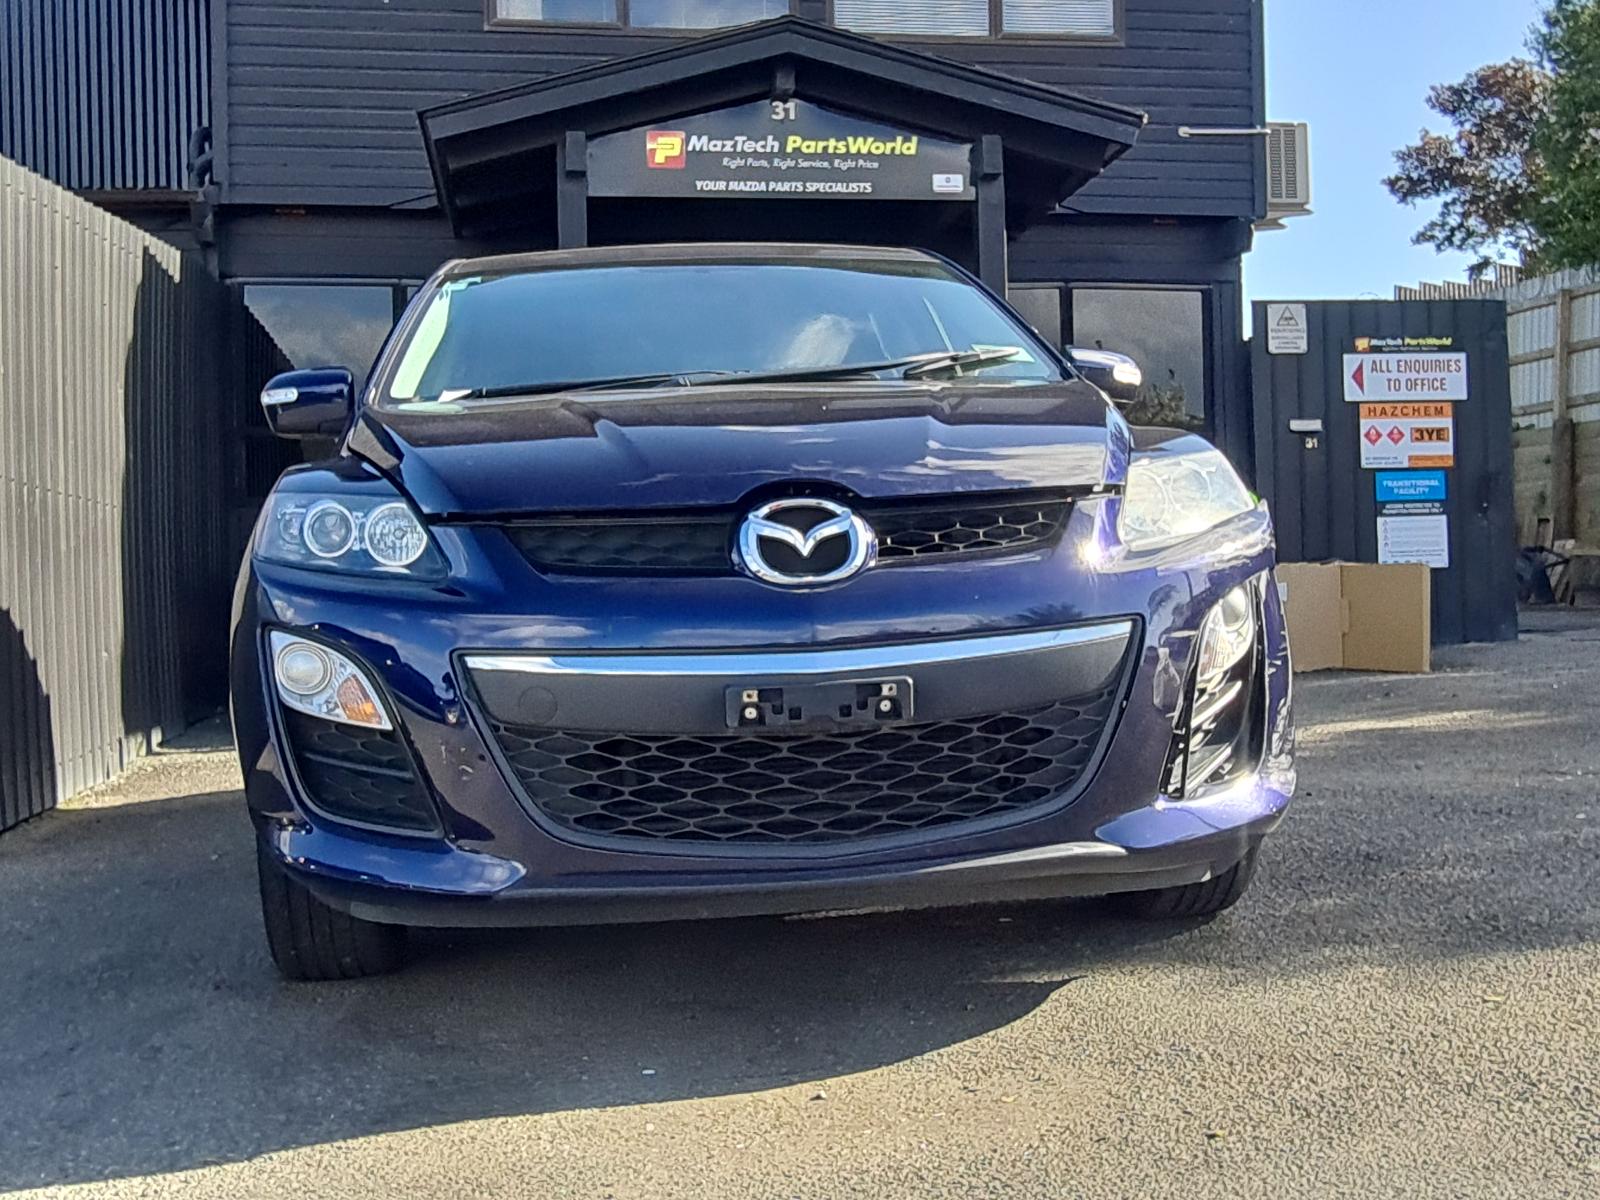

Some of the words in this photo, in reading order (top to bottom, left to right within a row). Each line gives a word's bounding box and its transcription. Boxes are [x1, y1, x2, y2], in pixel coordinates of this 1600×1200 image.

[771, 101, 796, 120] 31
[687, 135, 780, 153] MazTech
[786, 135, 918, 155] PartsWorld
[722, 157, 745, 169] Right
[746, 157, 770, 168] Parts,
[773, 158, 796, 170] Right
[797, 158, 831, 169] Service,
[833, 158, 856, 170] Right
[857, 159, 880, 169] Price
[695, 180, 726, 191] YOUR
[728, 181, 766, 192] MAZDA
[768, 181, 803, 192] PARTS
[805, 182, 873, 193] SPECIALISTS
[1370, 359, 1392, 374] ALL
[1396, 359, 1462, 375] ENQUIRIES
[1386, 378, 1401, 392] TO
[1405, 377, 1448, 392] OFFICE
[1367, 405, 1444, 417] HAZCHEM
[1414, 428, 1446, 441] 3YE
